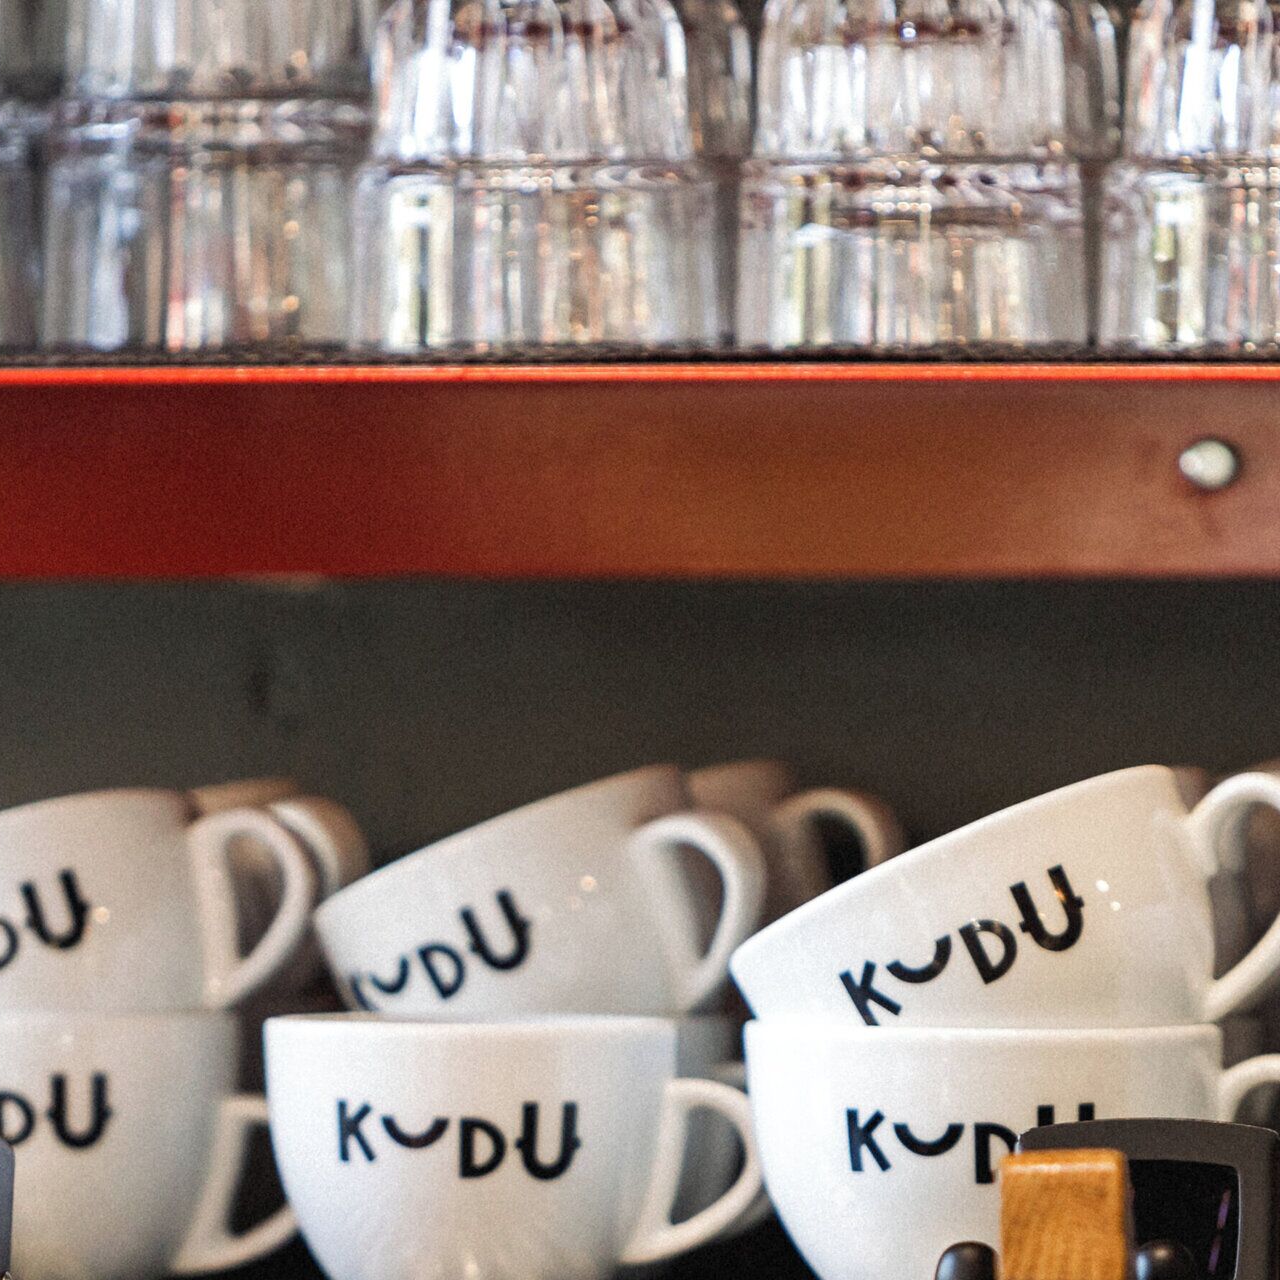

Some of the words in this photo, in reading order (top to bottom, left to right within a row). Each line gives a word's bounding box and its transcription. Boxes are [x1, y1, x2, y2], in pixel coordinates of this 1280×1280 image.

[838, 865, 1085, 1026] KUDU
[335, 1098, 581, 1180] KUDU
[846, 1102, 1096, 1184] KUD
